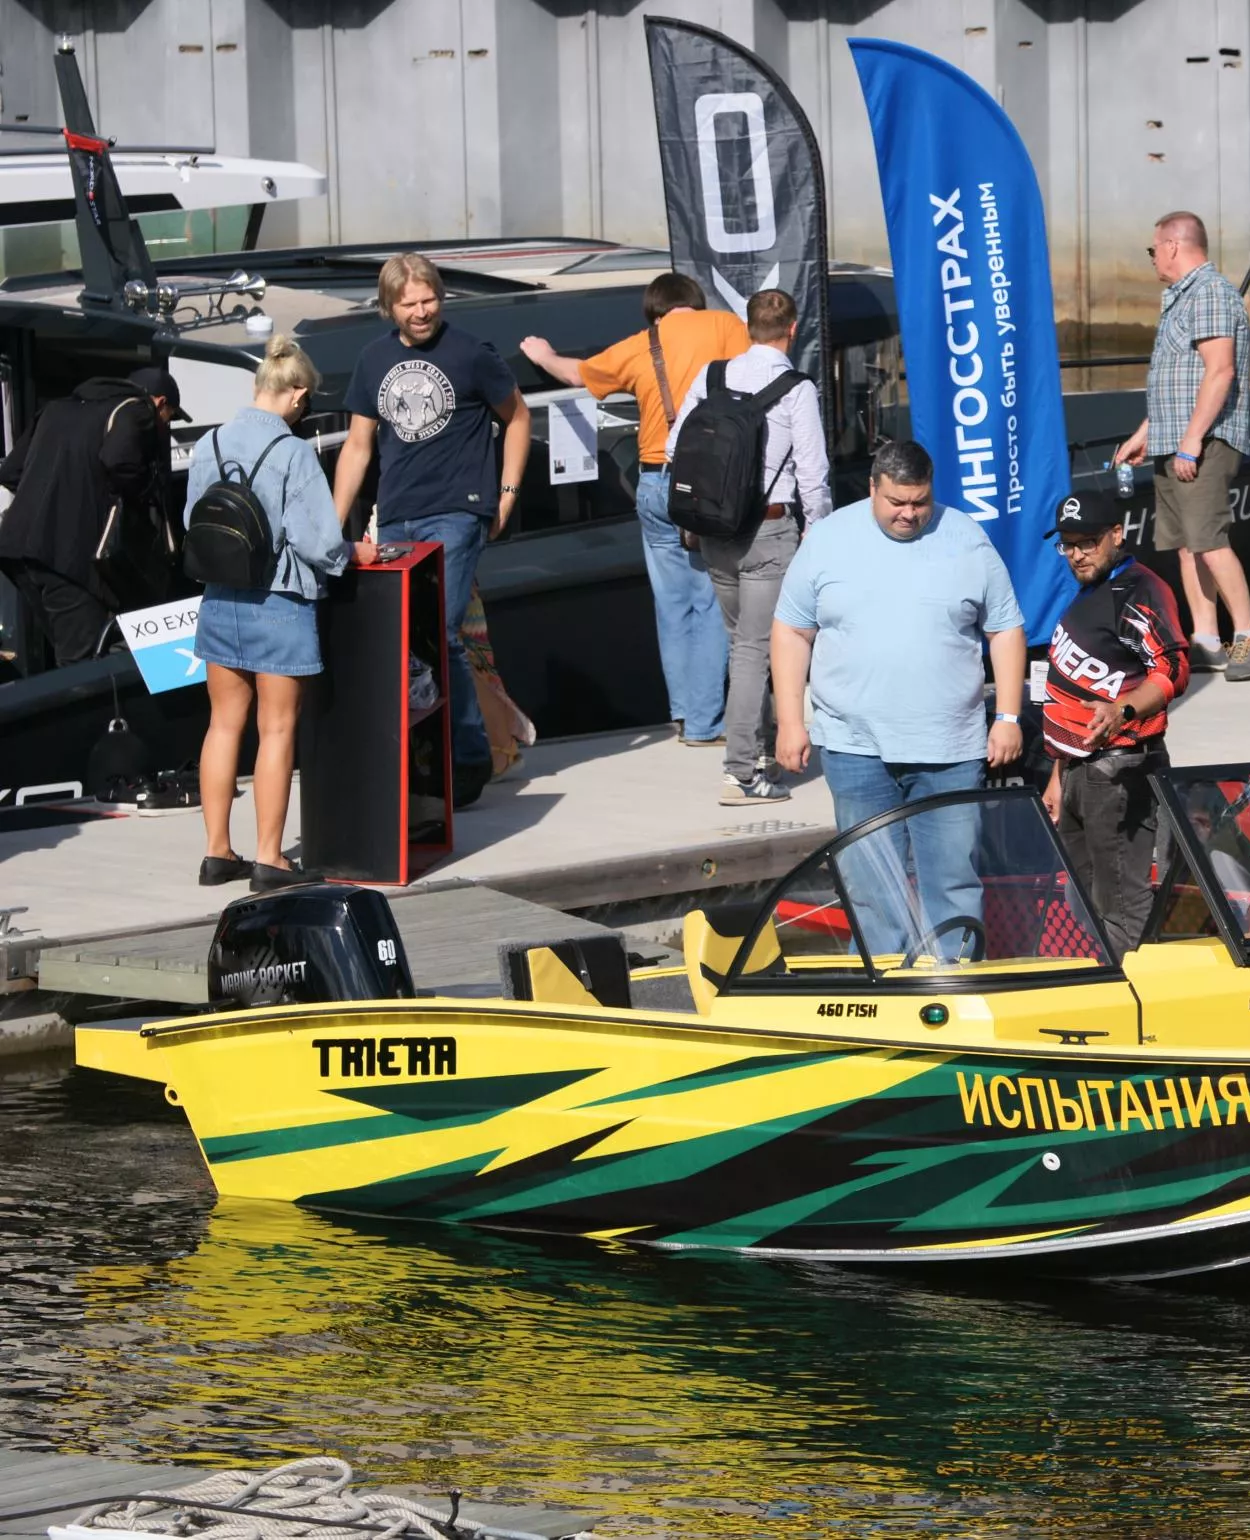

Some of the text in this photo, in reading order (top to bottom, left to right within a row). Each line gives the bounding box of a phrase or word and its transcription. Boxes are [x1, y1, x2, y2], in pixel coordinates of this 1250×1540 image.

[929, 187, 999, 521] ИНГОССТРАХ
[978, 182, 1024, 514] Просто быть уверенным
[130, 610, 199, 638] XO EXP
[1051, 623, 1126, 699] РИЕРА
[377, 939, 396, 961] 60
[221, 961, 307, 994] MARINE ROCKET
[817, 1003, 878, 1018] 460 FISH
[312, 1037, 457, 1077] TRIERA
